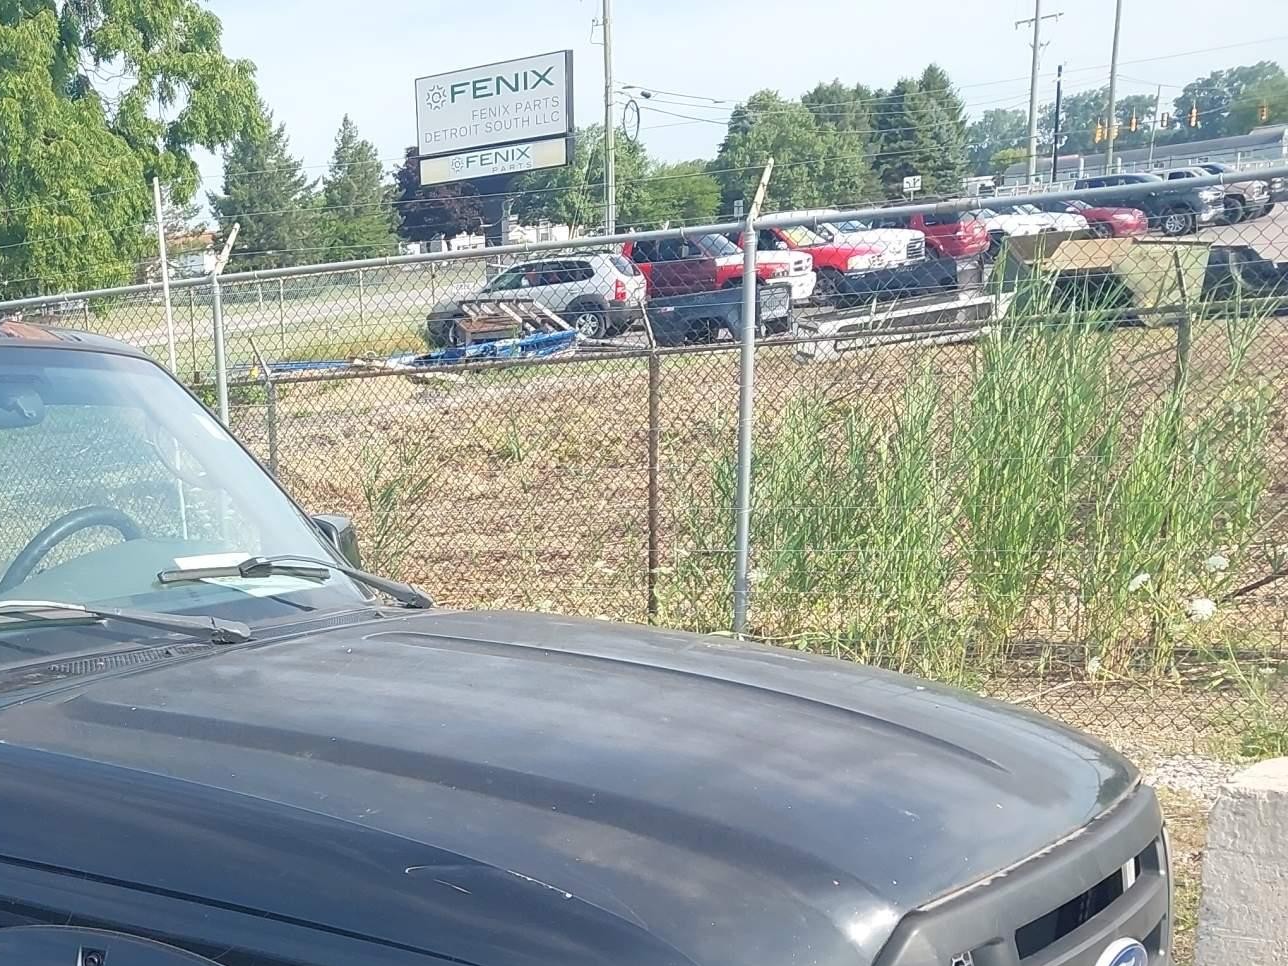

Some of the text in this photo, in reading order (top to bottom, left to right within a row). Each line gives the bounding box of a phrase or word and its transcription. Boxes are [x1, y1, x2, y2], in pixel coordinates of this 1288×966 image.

[450, 66, 555, 104] FENIX
[472, 96, 560, 121] FENIX PARTS
[424, 110, 560, 144] DETROIT SOUTH LLC
[466, 146, 531, 168] FENIX
[491, 161, 533, 174] PARTS
